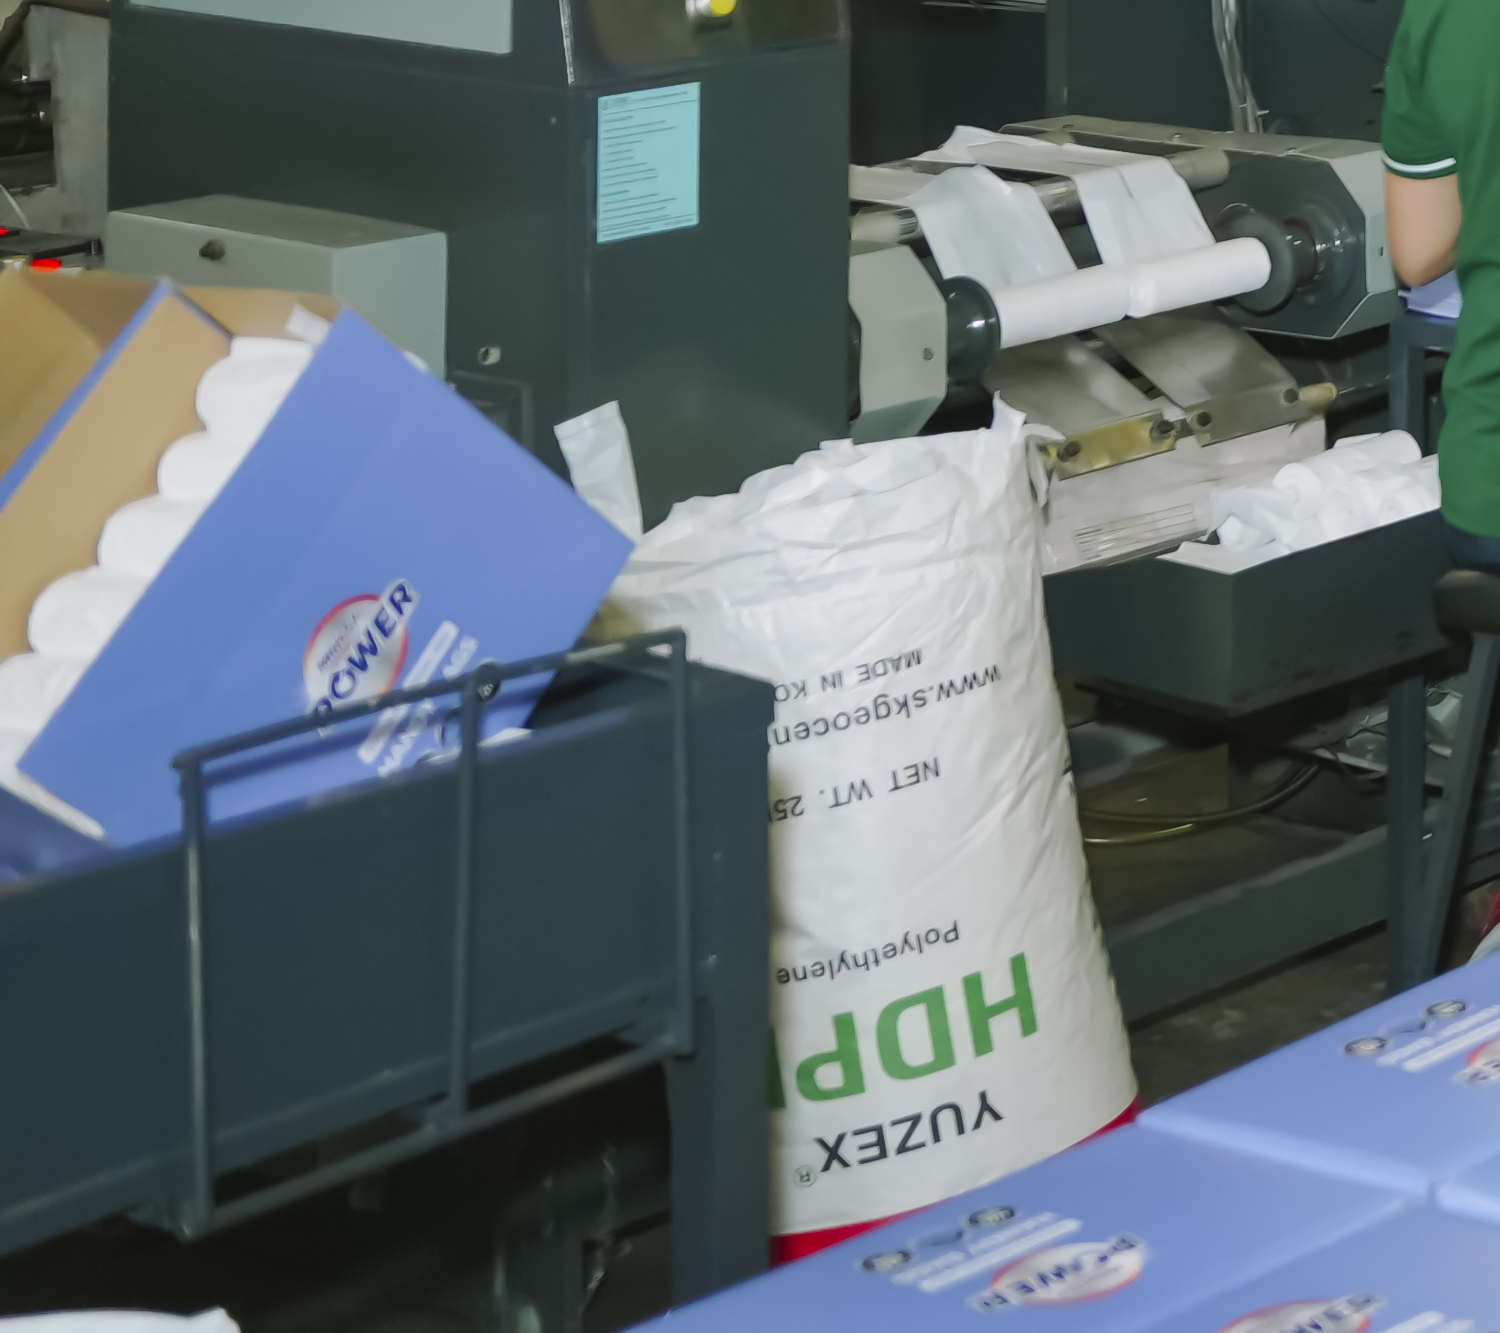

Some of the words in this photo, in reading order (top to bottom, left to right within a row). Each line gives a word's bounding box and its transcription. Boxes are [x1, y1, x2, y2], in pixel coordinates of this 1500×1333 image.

[820, 670, 844, 692] IN
[855, 647, 923, 684] MADE
[773, 663, 1002, 747] www.skgeocen
[774, 679, 808, 704] KO
[888, 756, 941, 793] NET
[818, 779, 875, 810] WT.
[776, 918, 960, 985] Polyethylene
